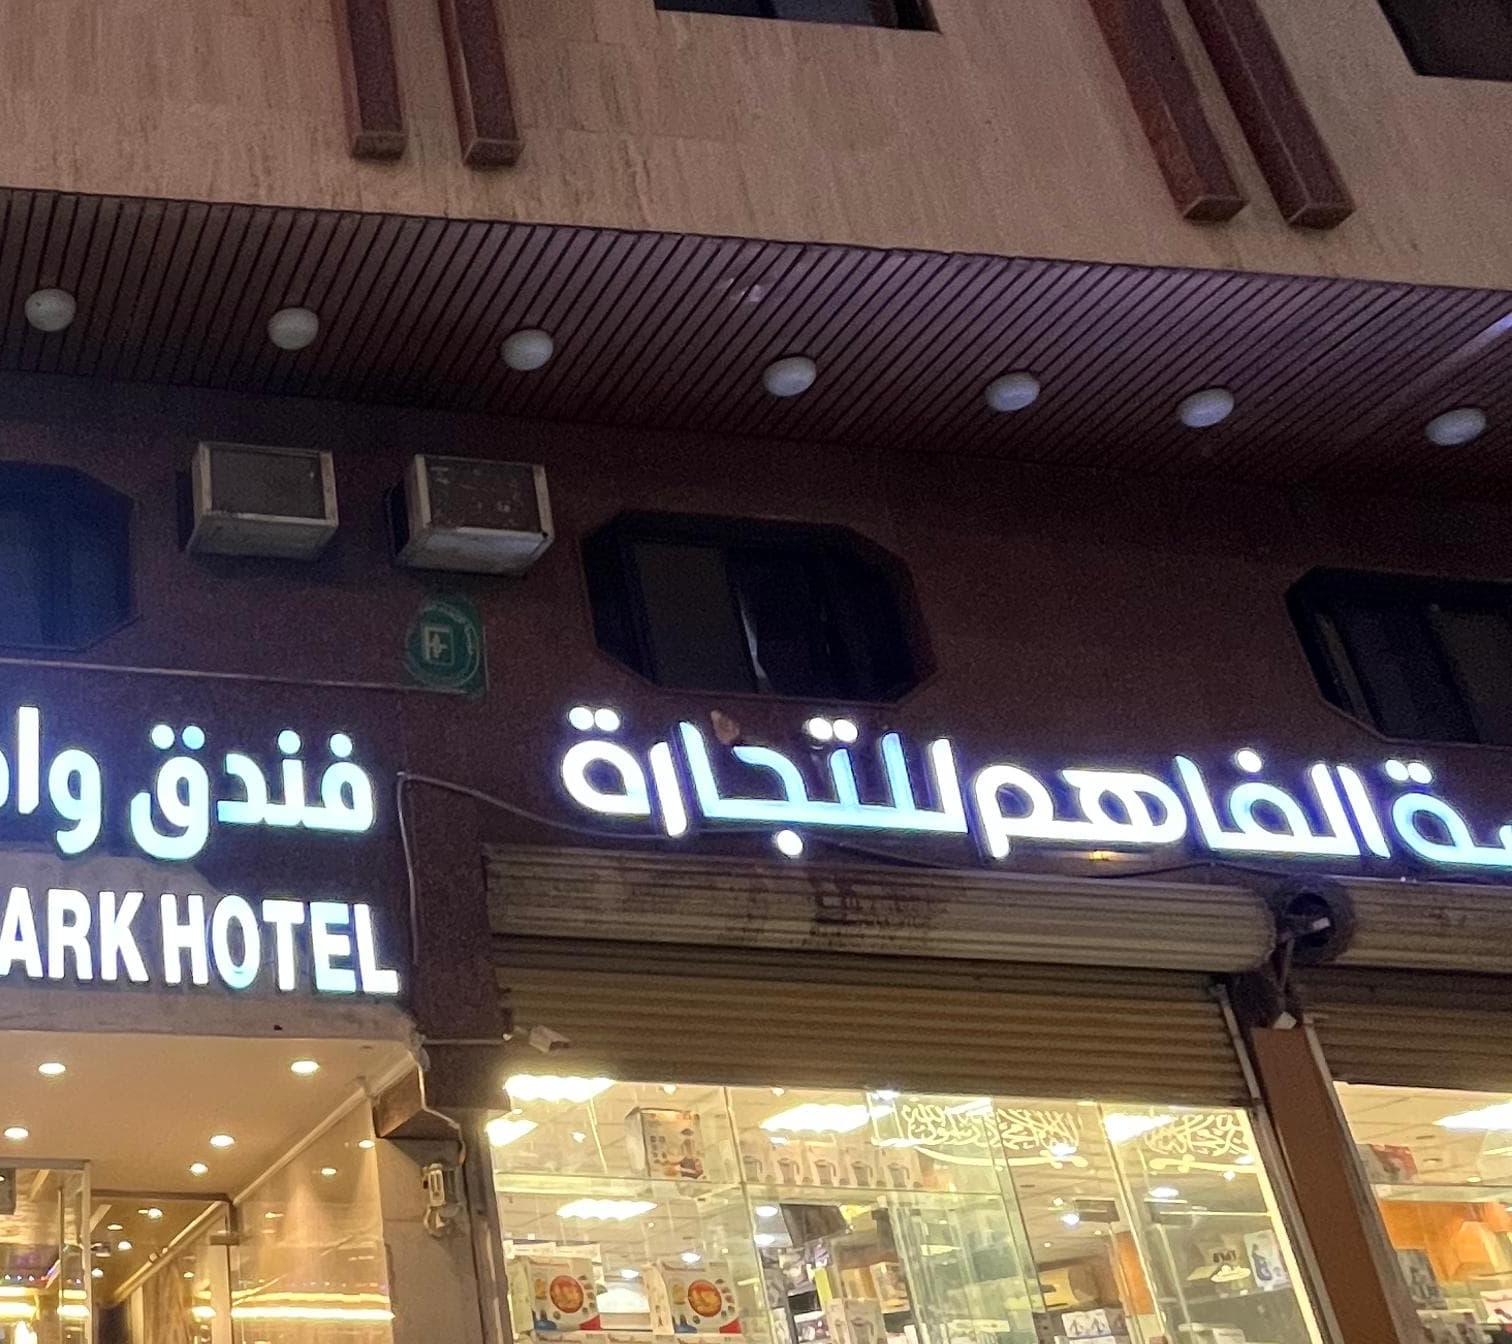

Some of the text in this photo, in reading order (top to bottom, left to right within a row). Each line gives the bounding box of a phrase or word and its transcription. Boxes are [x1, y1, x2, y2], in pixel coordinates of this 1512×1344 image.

[130, 724, 375, 860] فندق
[562, 707, 970, 856] للتجارة
[974, 750, 1391, 863] الفاهم
[160, 893, 399, 994] HOTEL
